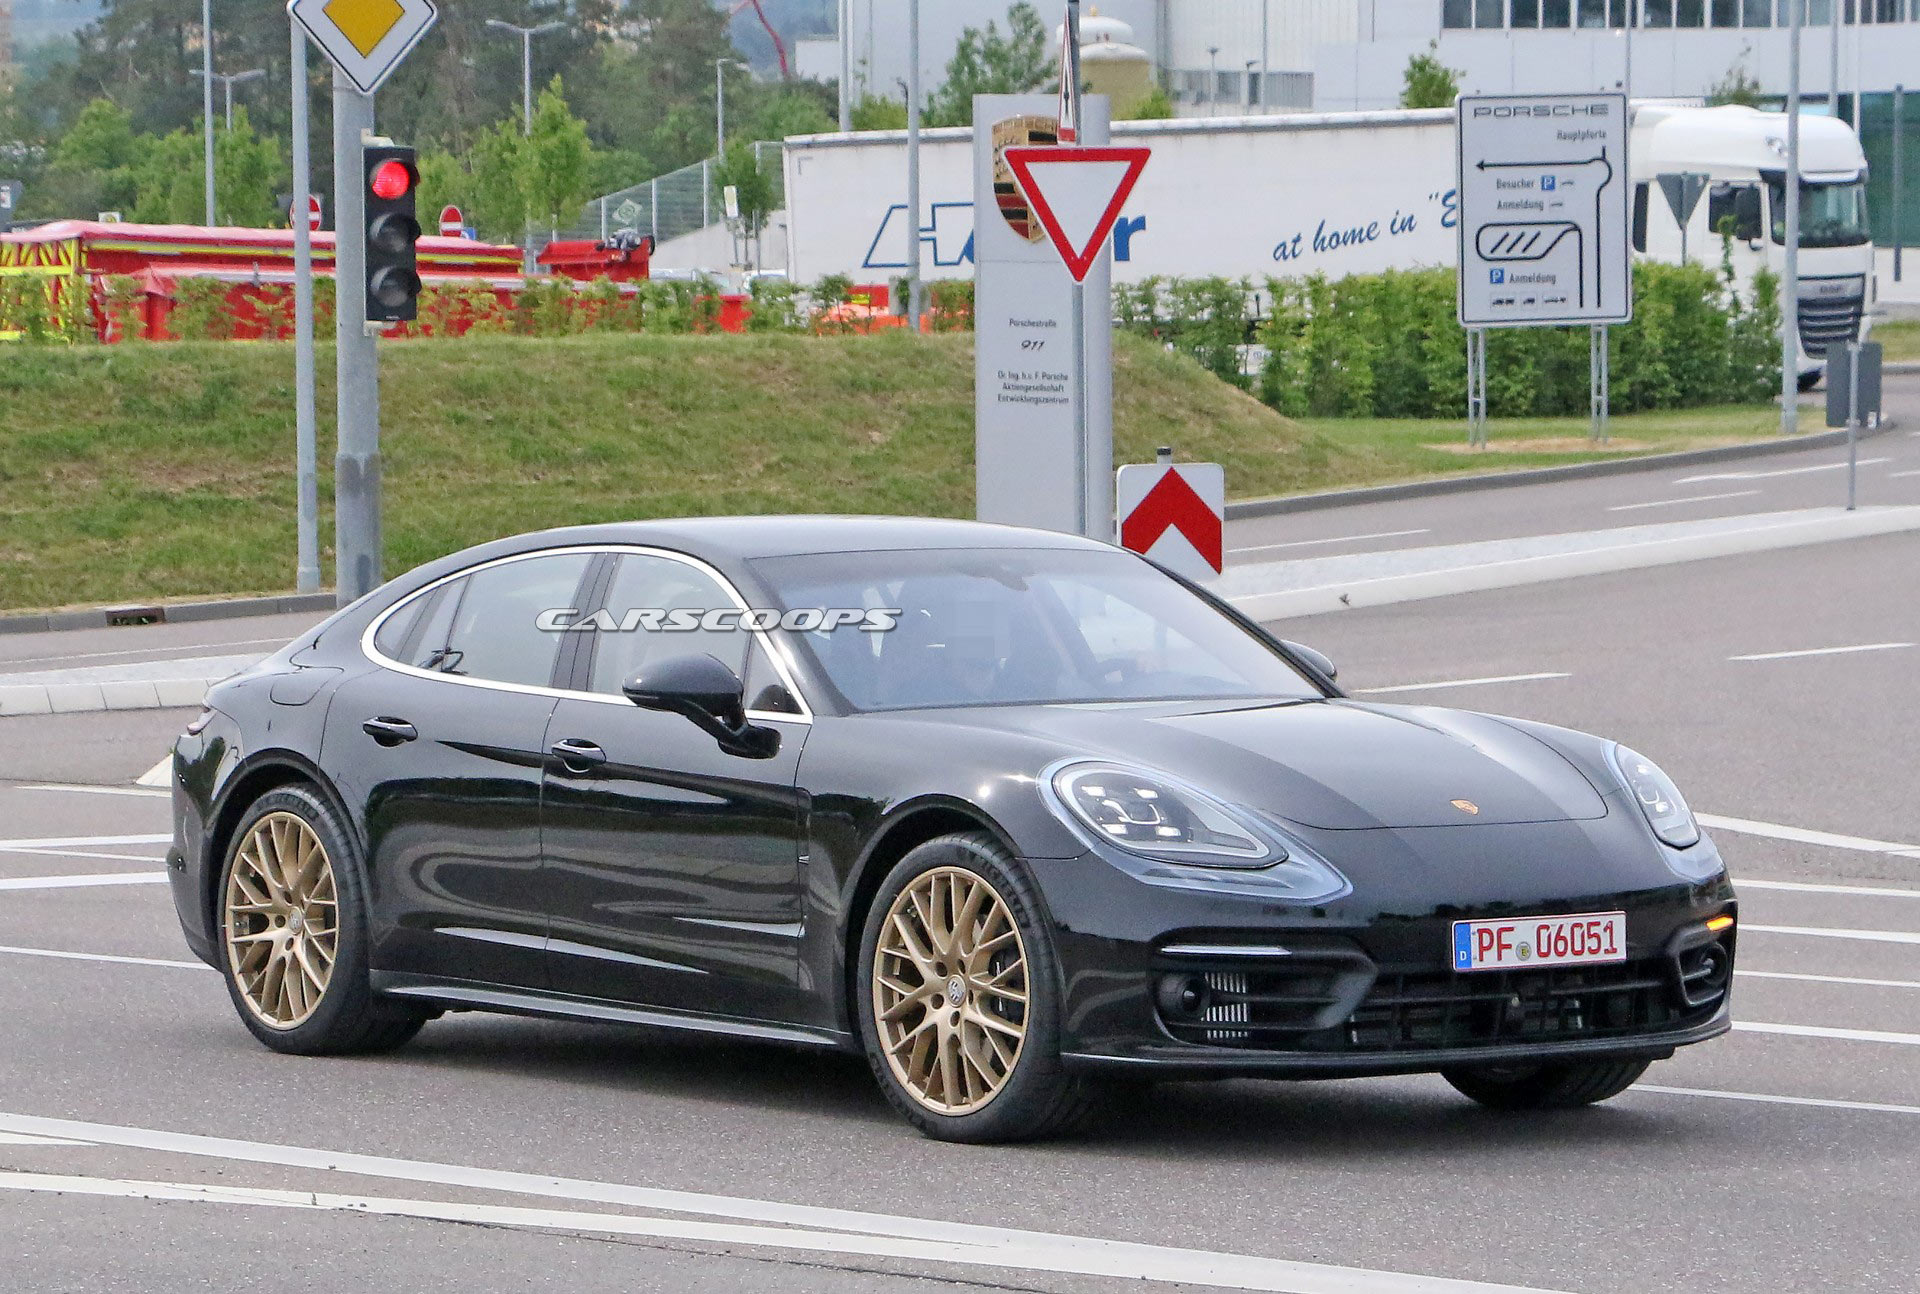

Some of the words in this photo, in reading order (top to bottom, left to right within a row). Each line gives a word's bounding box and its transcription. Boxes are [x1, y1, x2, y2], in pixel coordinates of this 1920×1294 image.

[1473, 104, 1609, 118] PORSCHE
[1557, 130, 1607, 142] Hauptpforte
[1496, 178, 1535, 189] Besucher
[1496, 200, 1544, 211] Anmeldung
[1272, 232, 1303, 262] at
[1312, 218, 1381, 253] home
[1389, 209, 1418, 236] in
[1509, 273, 1556, 285] Anmeldung
[1021, 340, 1045, 350] 911
[1042, 371, 1069, 381] Porsche
[1460, 951, 1467, 961] D
[1477, 926, 1515, 962] PF
[1535, 920, 1618, 958] 06051
